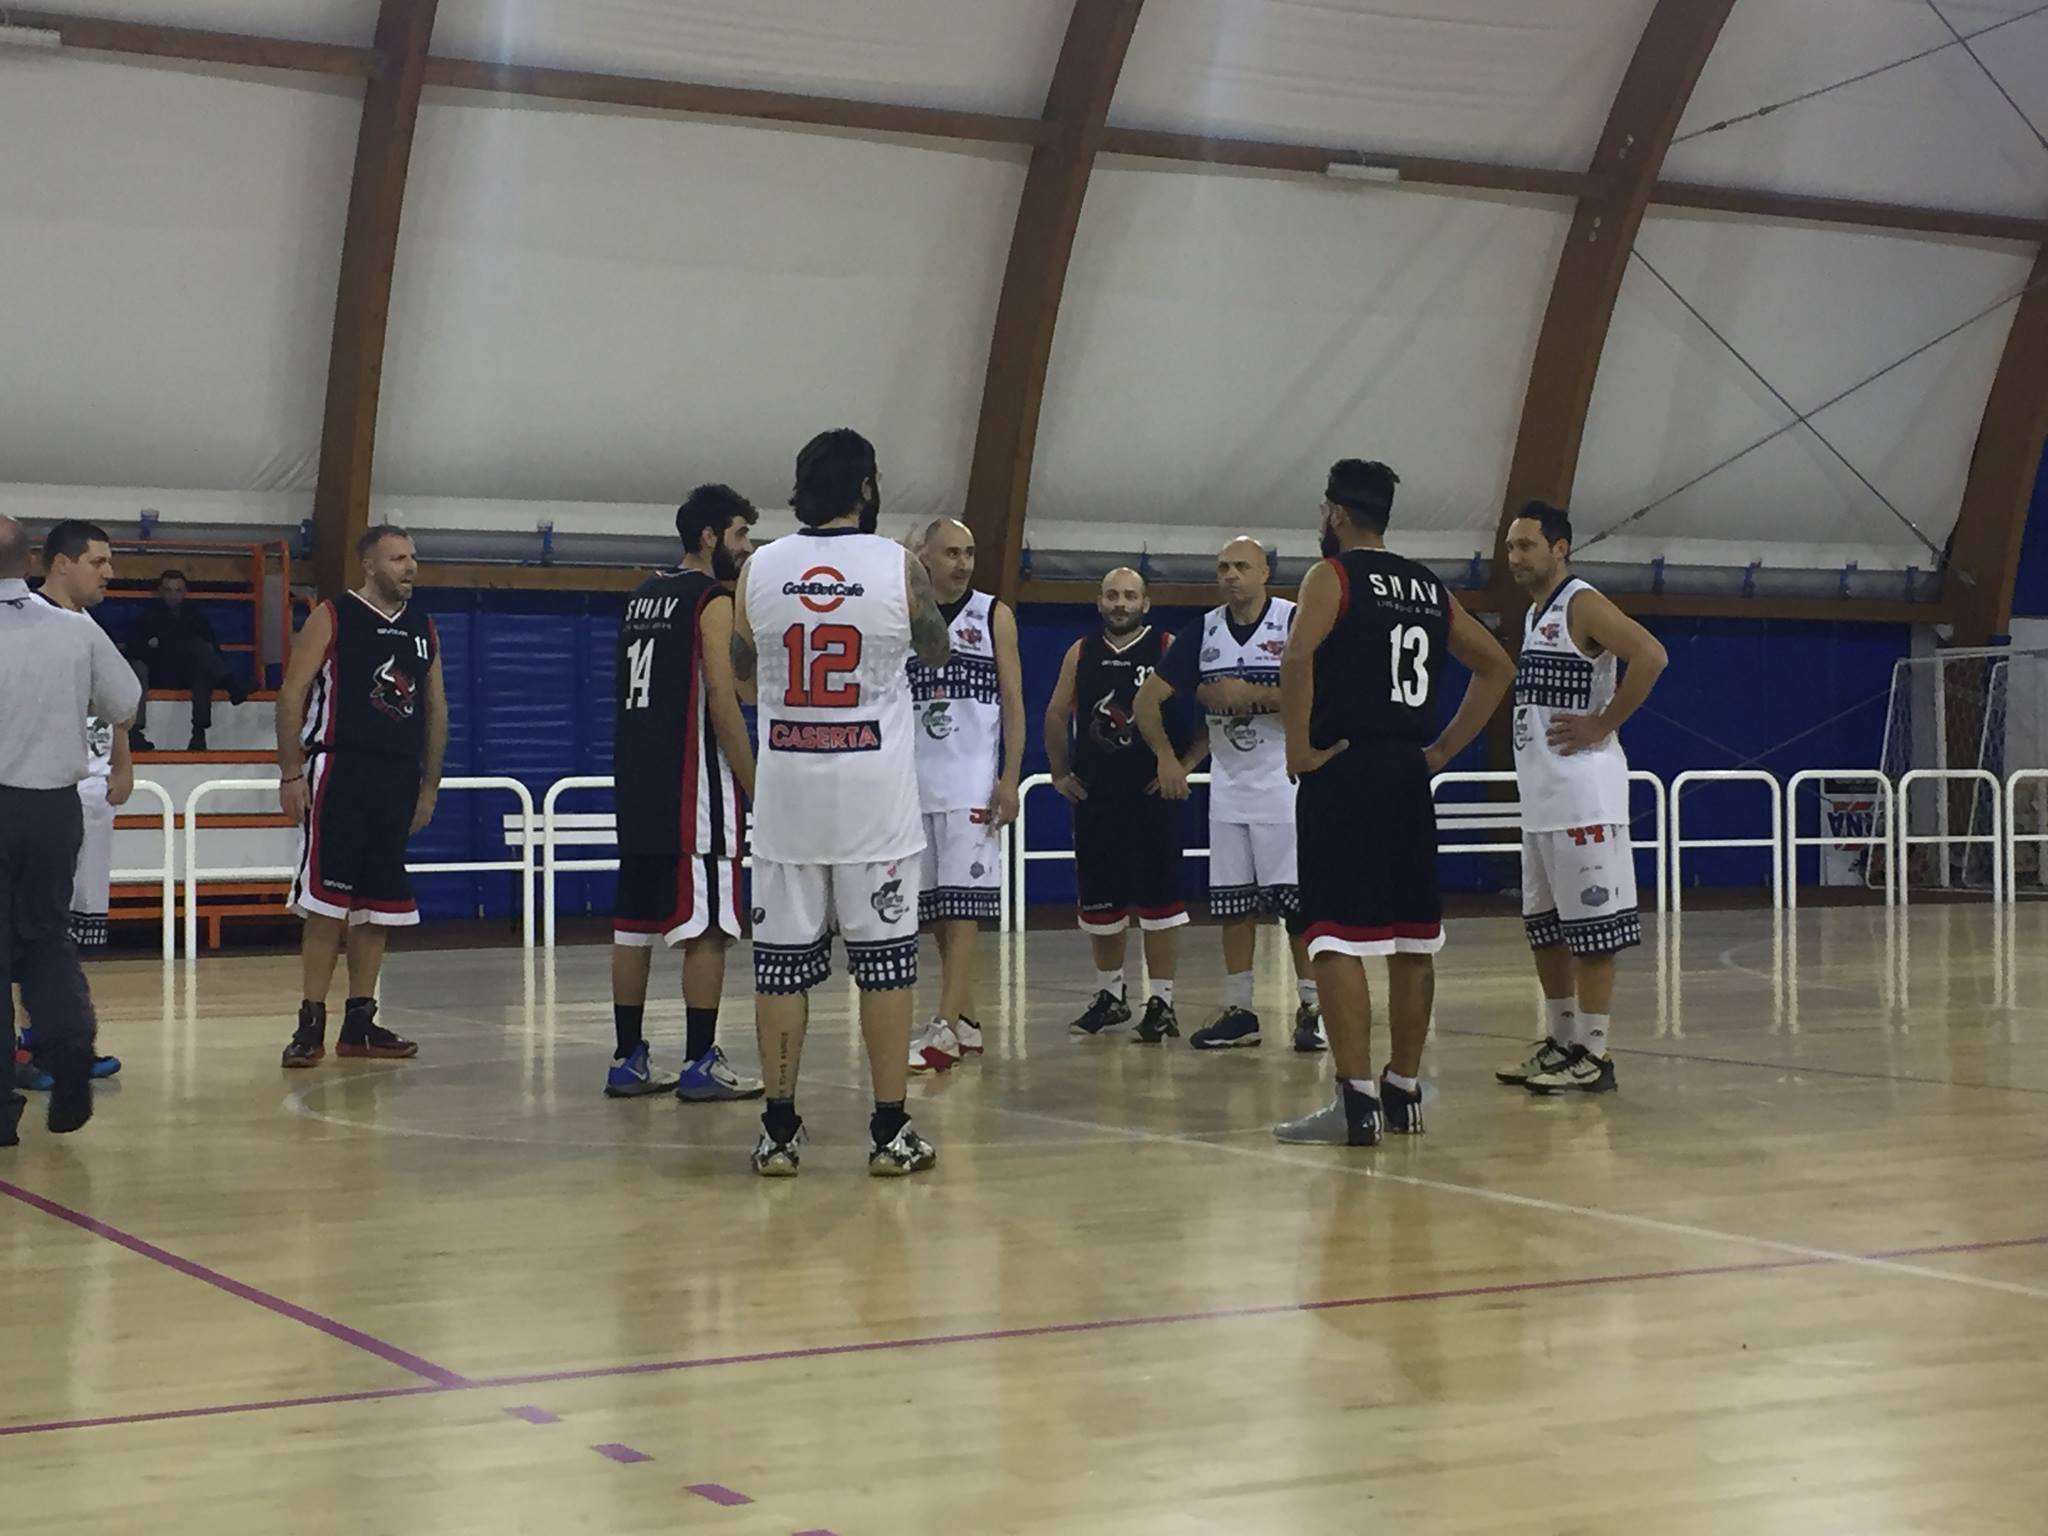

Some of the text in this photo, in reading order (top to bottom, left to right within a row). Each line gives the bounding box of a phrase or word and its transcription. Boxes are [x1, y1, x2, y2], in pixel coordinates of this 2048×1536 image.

[414, 636, 428, 660] 11
[625, 637, 656, 710] 14
[782, 623, 863, 708] 12
[1389, 623, 1430, 708] 13
[771, 724, 878, 749] CASERTA
